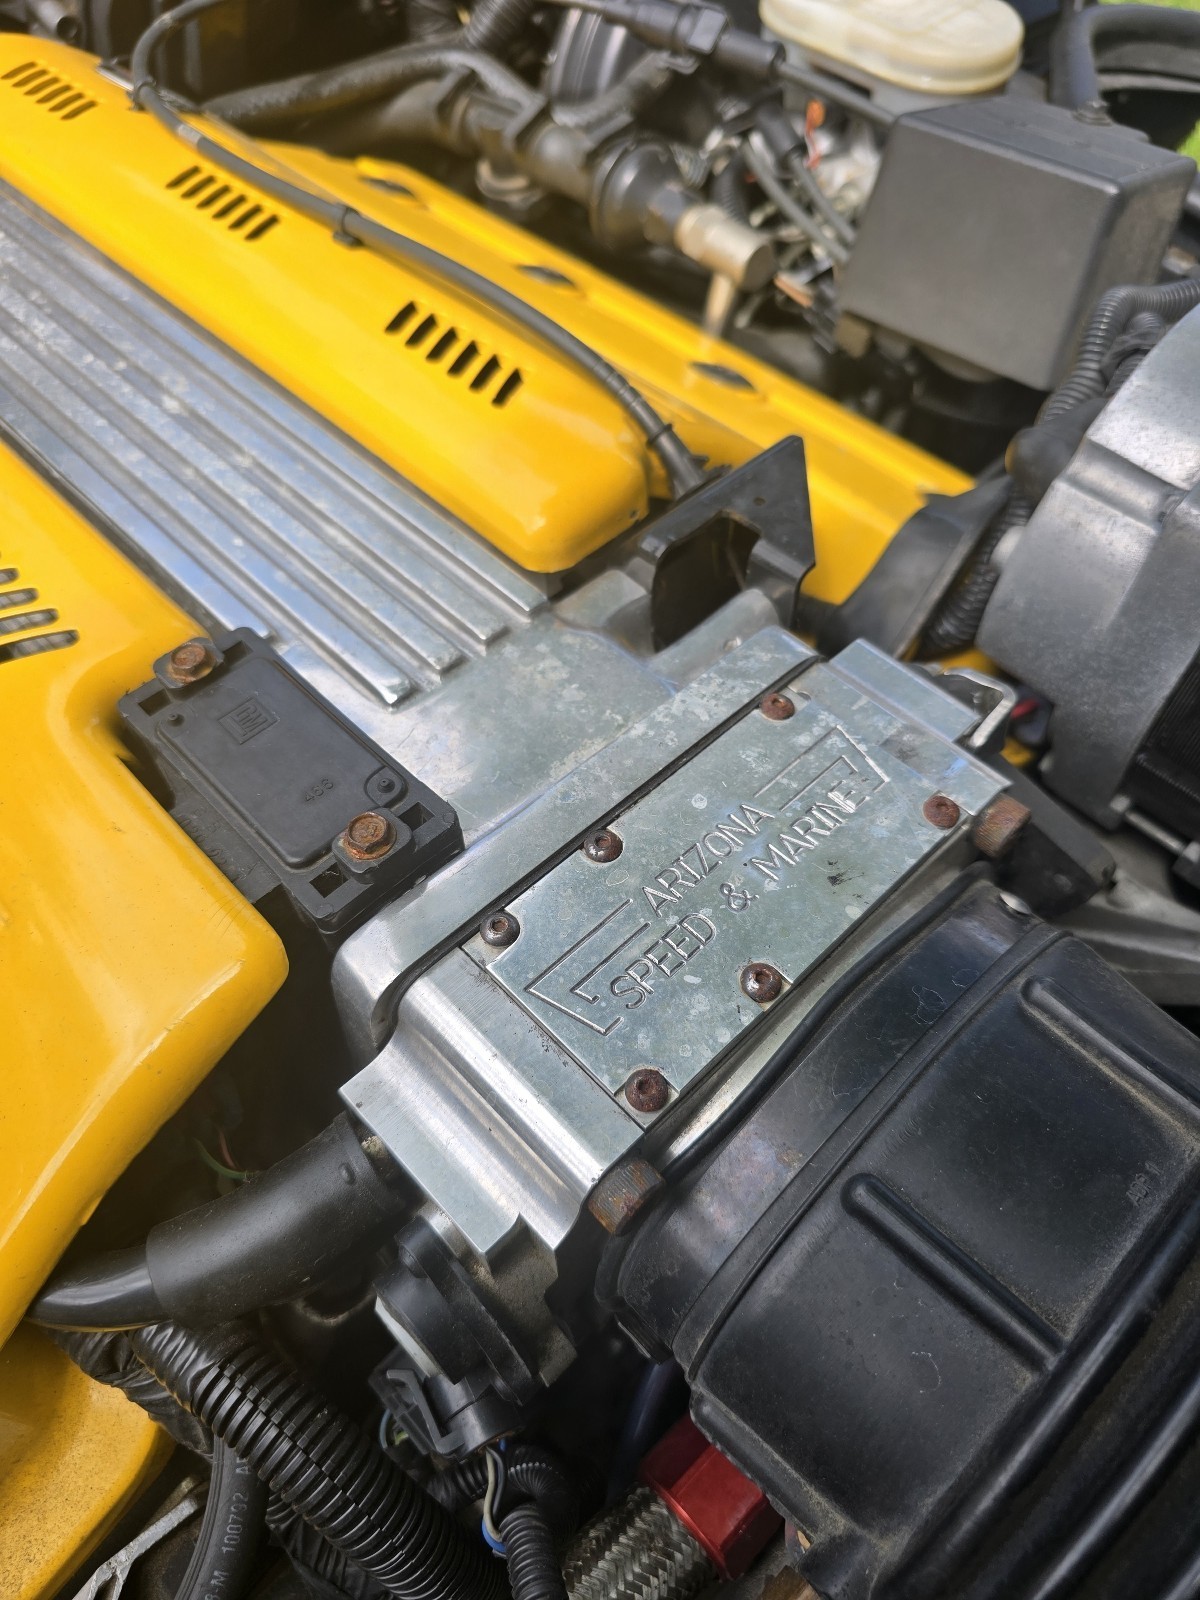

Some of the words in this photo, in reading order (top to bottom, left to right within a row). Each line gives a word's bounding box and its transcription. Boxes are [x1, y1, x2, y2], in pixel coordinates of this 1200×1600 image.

[610, 912, 717, 1009] SPEED
[719, 882, 760, 914] &
[751, 779, 871, 882] MARINE
[641, 803, 776, 918] ARIZONA
[221, 1492, 249, 1555] 100792
